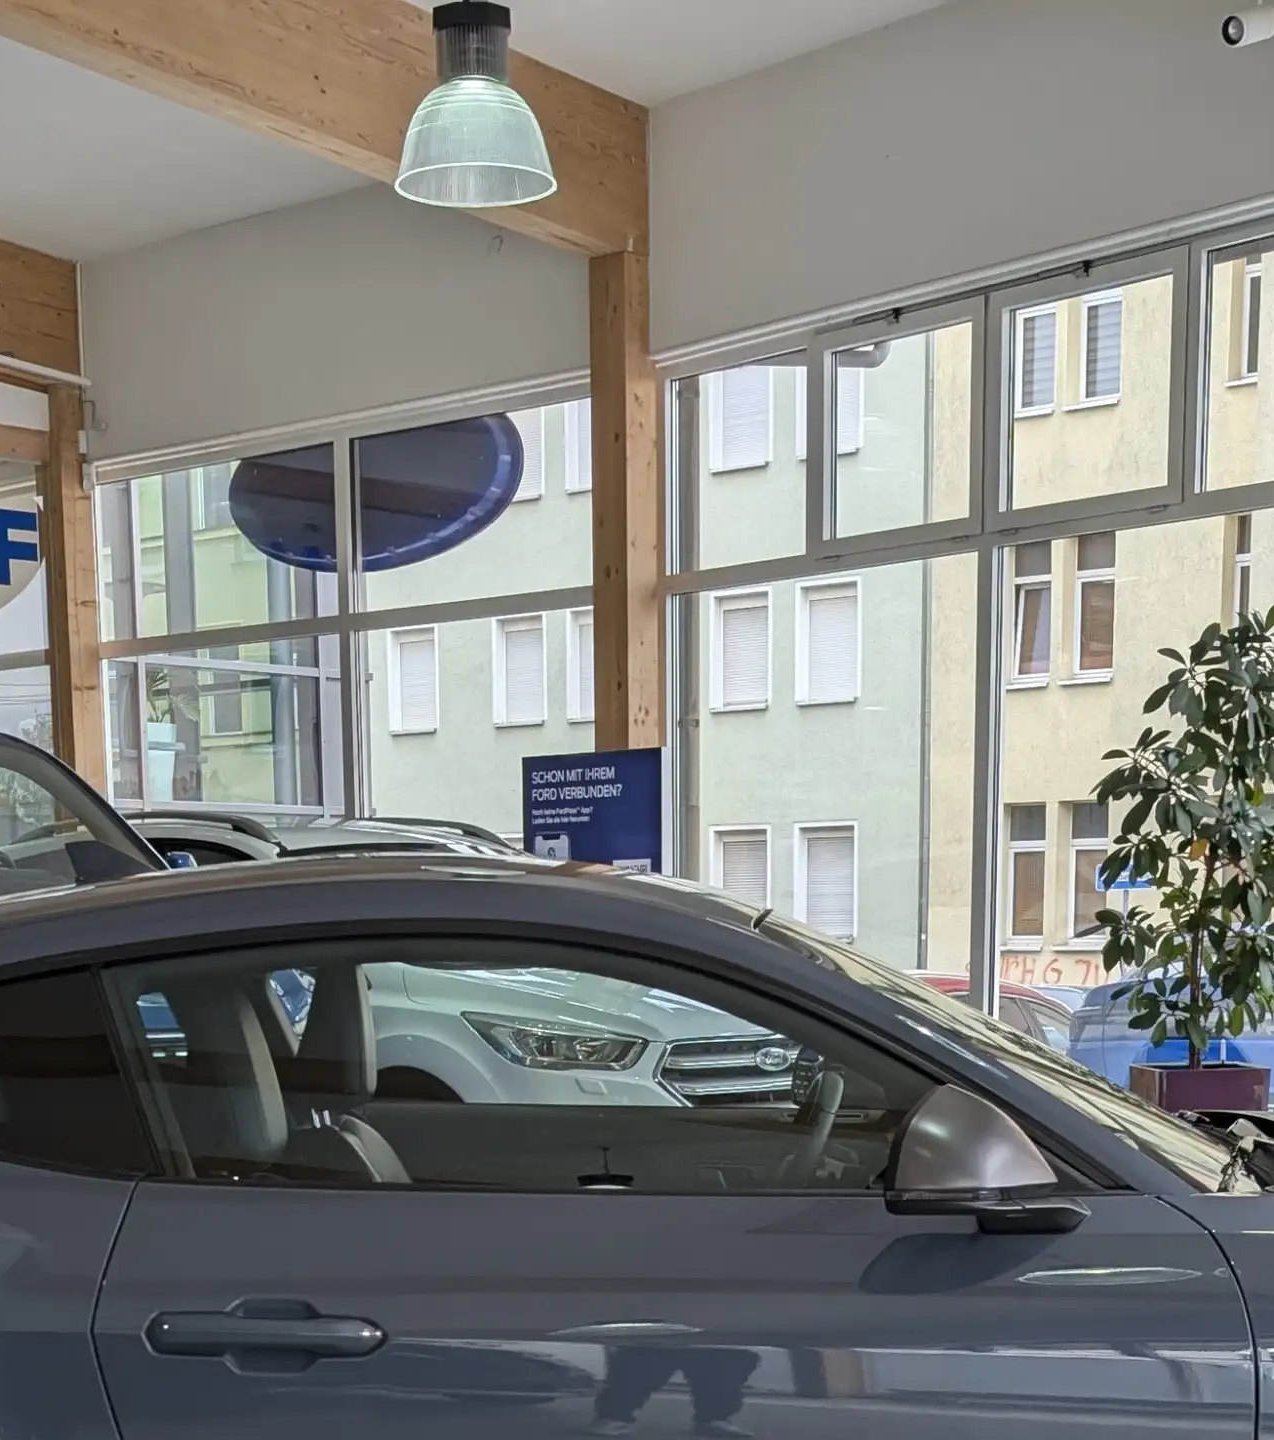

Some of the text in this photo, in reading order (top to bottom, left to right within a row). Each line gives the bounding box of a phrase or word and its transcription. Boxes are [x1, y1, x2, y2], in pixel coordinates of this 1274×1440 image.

[532, 766, 616, 785] SCHON MIT IHREM
[532, 784, 623, 801] FORD VERBUNDEN?
